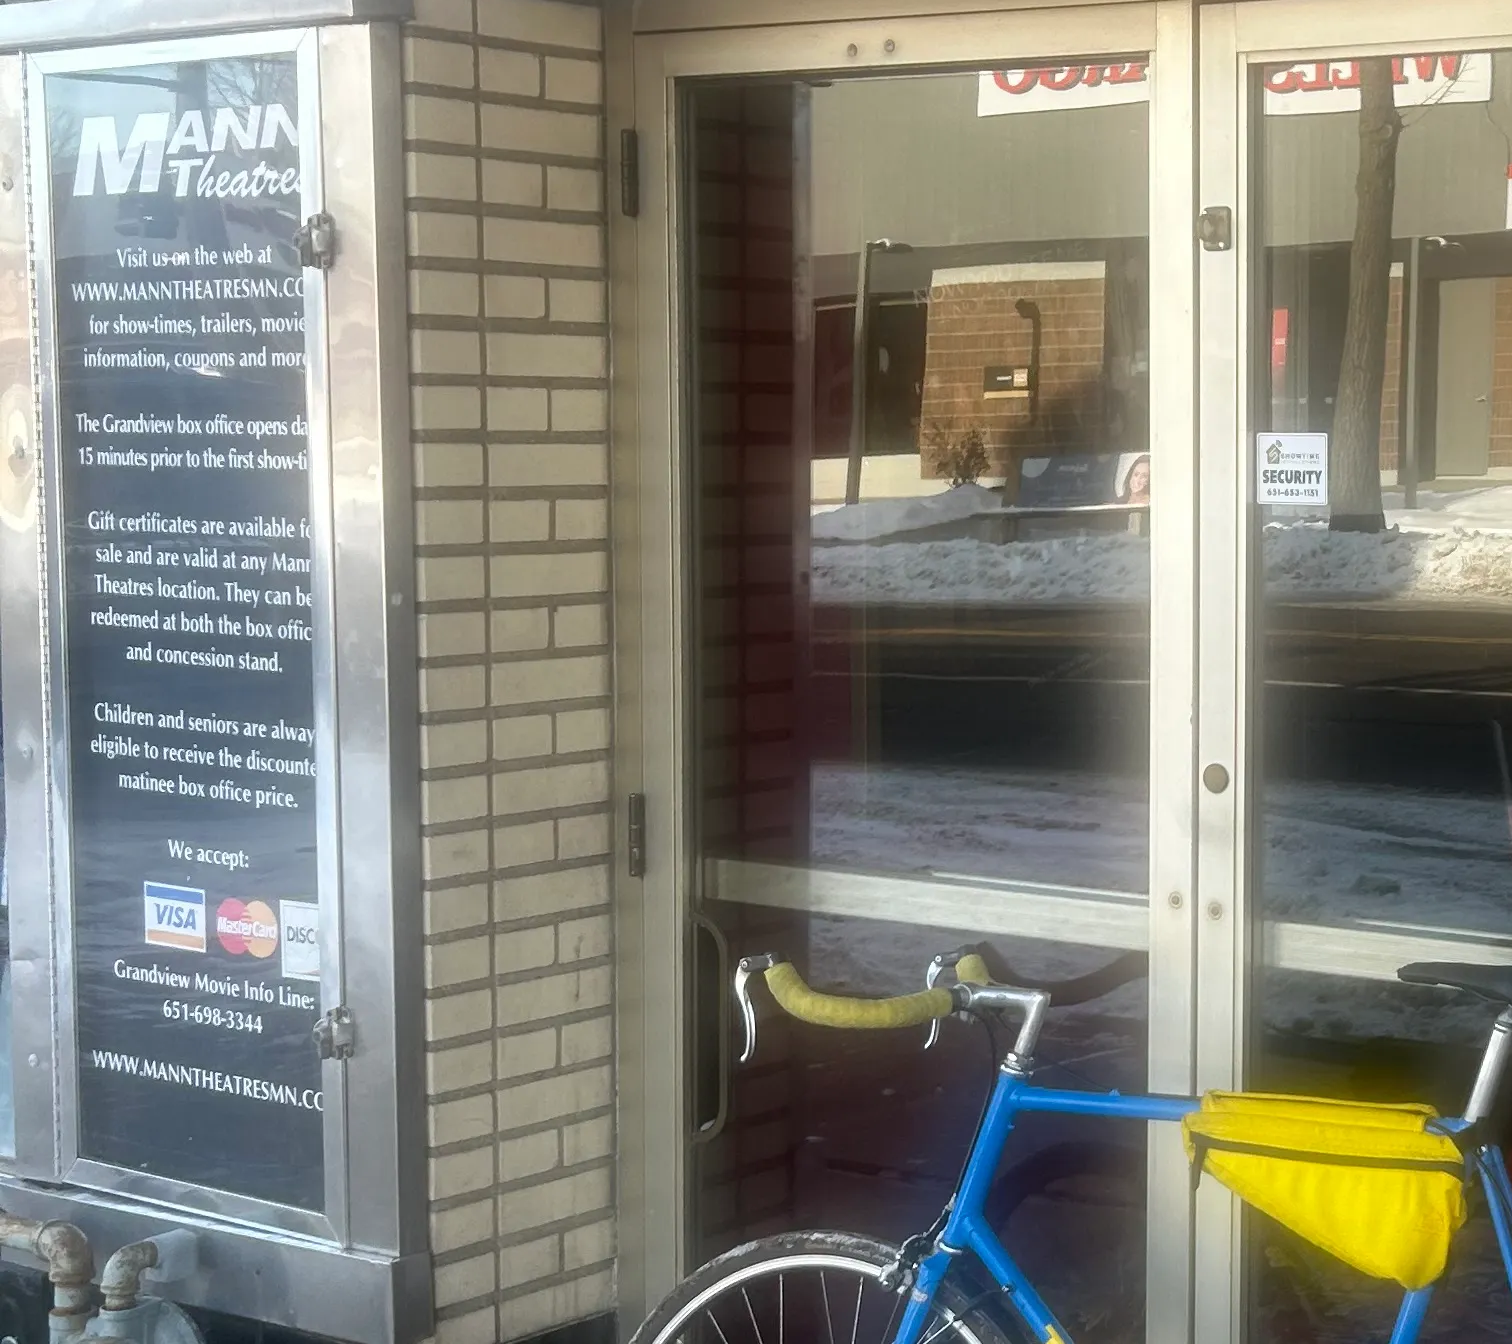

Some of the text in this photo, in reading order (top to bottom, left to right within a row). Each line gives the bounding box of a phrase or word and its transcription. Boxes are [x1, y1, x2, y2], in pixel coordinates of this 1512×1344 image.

[73, 104, 299, 197] MANN
[117, 244, 272, 268] Visit us on the web at
[89, 313, 108, 335] for
[113, 314, 195, 337] show-times,
[200, 314, 257, 336] trailers,
[84, 346, 267, 370] information, coupons and
[76, 413, 288, 439] The Grandview box office opens
[79, 446, 254, 472] 15 minutes prior to the first
[1263, 470, 1322, 484] SECURITY
[88, 510, 295, 538] Gift certificates are available
[96, 543, 122, 564] sale
[126, 544, 153, 565] and
[156, 550, 179, 567] are
[183, 546, 218, 568] valid
[223, 551, 237, 569] at
[241, 555, 267, 575] any
[94, 574, 154, 597] Theatres
[158, 578, 221, 601] location.
[224, 581, 260, 607] They
[265, 589, 293, 605] can
[91, 607, 159, 630] redeemed
[162, 615, 177, 631] at
[180, 612, 214, 634] both
[218, 615, 242, 635] the
[245, 619, 273, 638] box
[126, 640, 283, 672] and concession stand.
[94, 702, 154, 728] Children
[157, 707, 184, 730] and
[188, 711, 239, 736] seniors
[243, 720, 267, 738] are
[91, 735, 140, 759] eligible
[144, 743, 159, 759] to
[163, 744, 214, 766] receive
[218, 747, 242, 768] the
[118, 771, 298, 808] matinee box office price.
[168, 839, 249, 870] We accept:
[154, 902, 197, 931] VISA
[217, 916, 277, 940] MasterCard
[113, 959, 314, 1010] Grandview Movie Info Line:
[163, 999, 262, 1033] 651-698-3344
